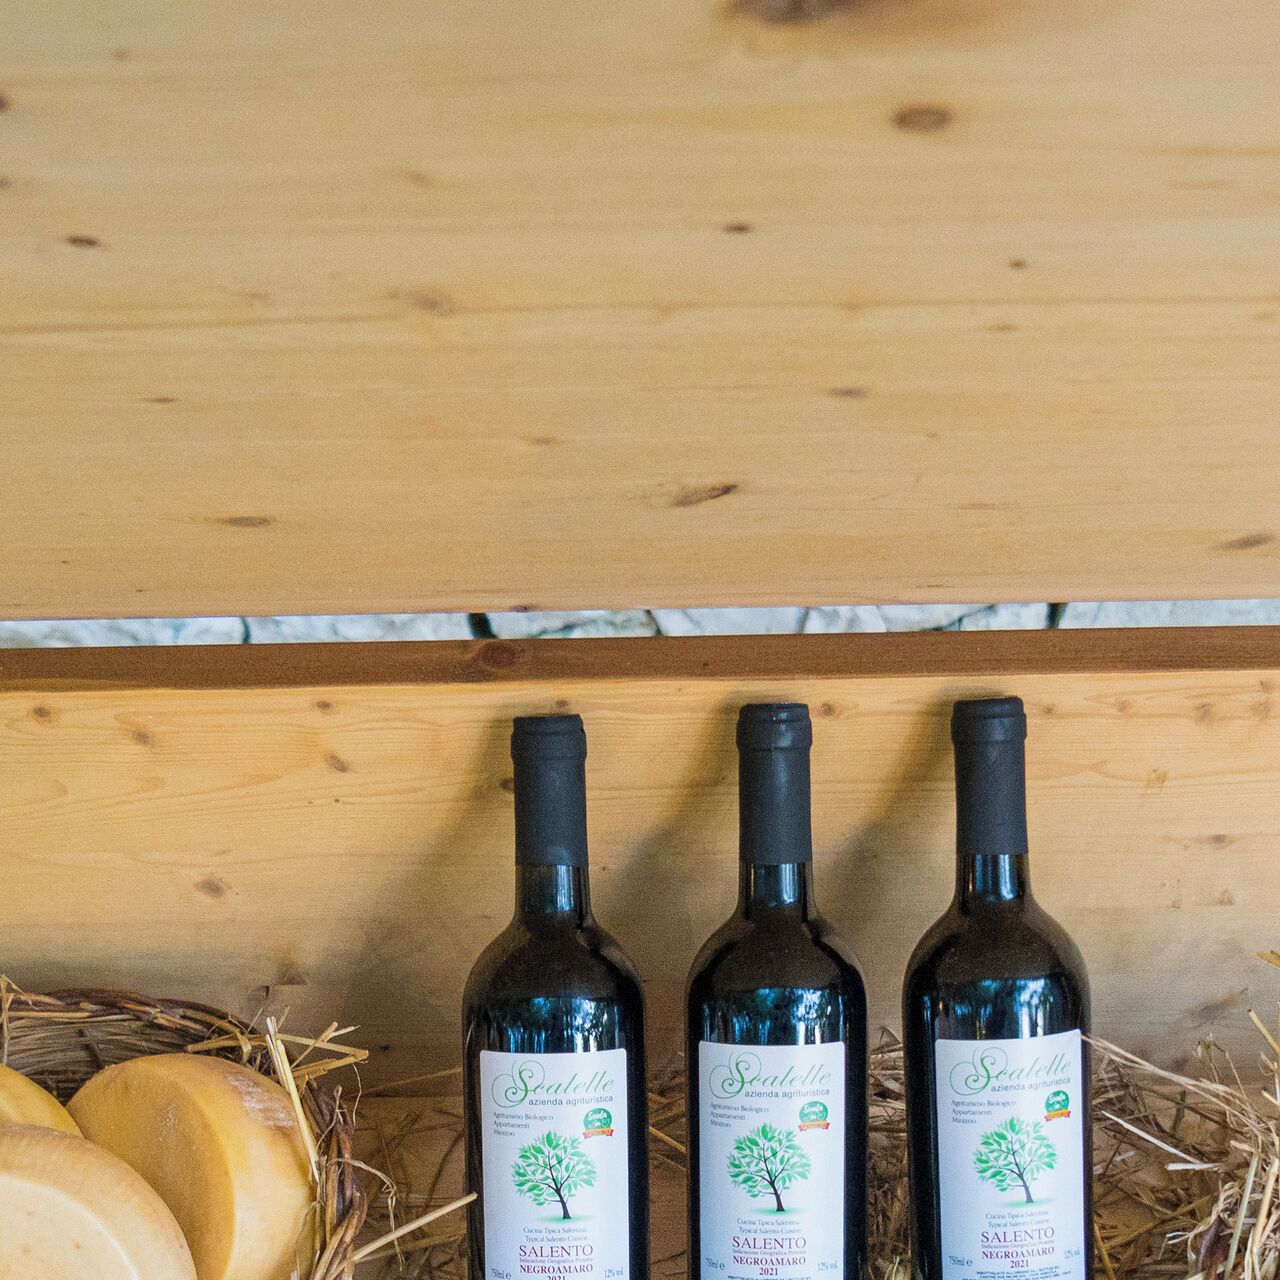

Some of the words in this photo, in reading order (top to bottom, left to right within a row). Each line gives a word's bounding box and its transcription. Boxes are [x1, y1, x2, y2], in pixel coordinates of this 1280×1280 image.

[708, 1051, 832, 1100] Scalelle
[949, 1046, 1072, 1096] Scalelle
[491, 1059, 615, 1109] Scalelle
[990, 1082, 1026, 1093] azienda
[1027, 1077, 1071, 1090] agrituristica
[744, 1089, 780, 1099] azienda
[781, 1087, 831, 1099] agrituristica
[528, 1098, 563, 1106] azienda
[565, 1095, 614, 1107] agrituristica
[731, 1235, 807, 1250] SALENTO
[980, 1227, 1055, 1244] SALENTO
[518, 1244, 594, 1258] SALENTO
[981, 1245, 1055, 1260] NEGROAMARO
[732, 1255, 807, 1266] NEGROAMARO
[1009, 1259, 1030, 1269] 2021
[519, 1263, 594, 1275] NEGROAMARO
[758, 1266, 779, 1276] 2021
